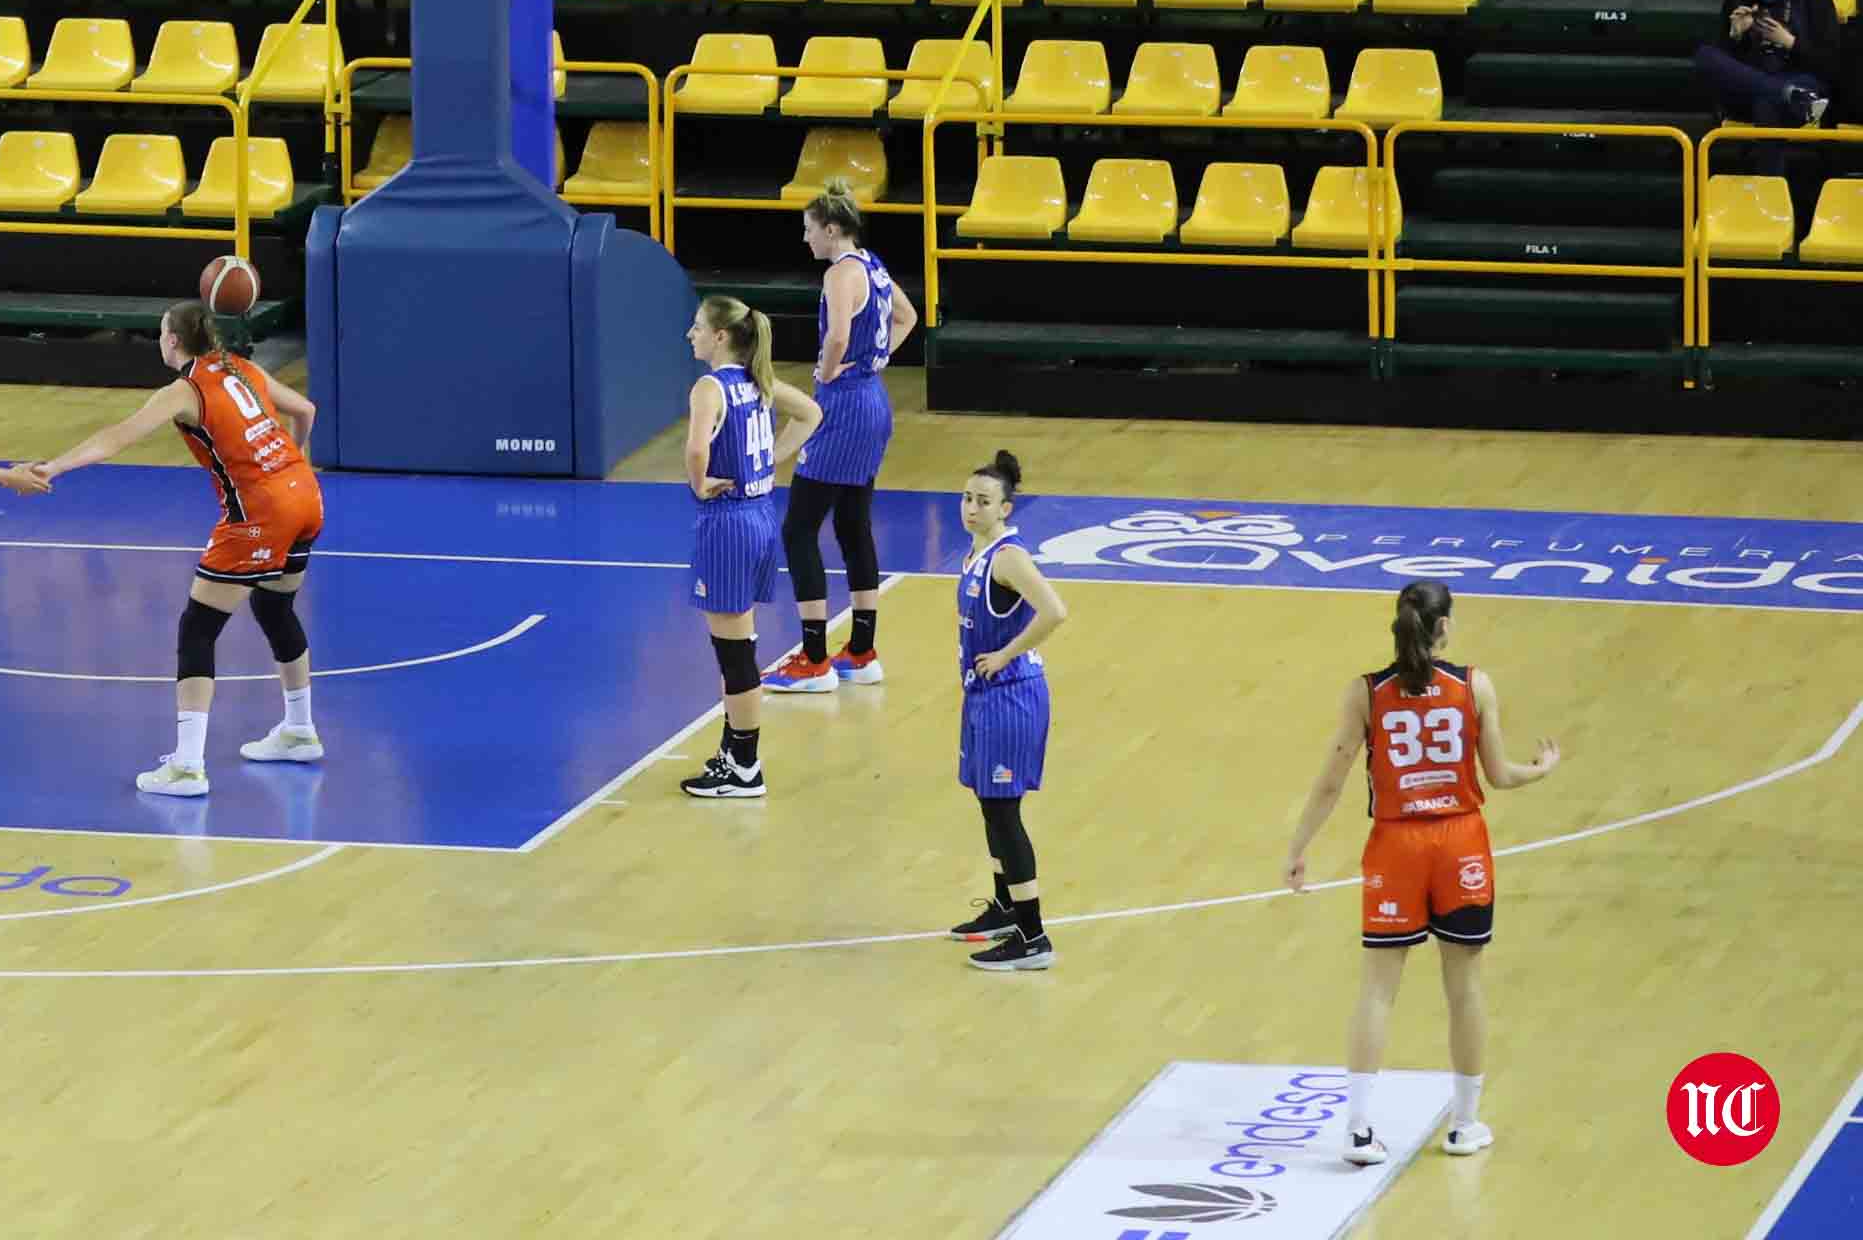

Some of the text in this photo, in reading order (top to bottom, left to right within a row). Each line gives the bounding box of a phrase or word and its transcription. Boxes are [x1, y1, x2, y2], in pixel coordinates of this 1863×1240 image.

[1594, 11, 1618, 21] FILA
[1526, 244, 1550, 254] FILA
[222, 374, 263, 420] 0
[495, 438, 556, 452] MONDO
[745, 404, 775, 473] 44
[1381, 706, 1464, 768] 33
[1209, 1072, 1348, 1178] endesa
